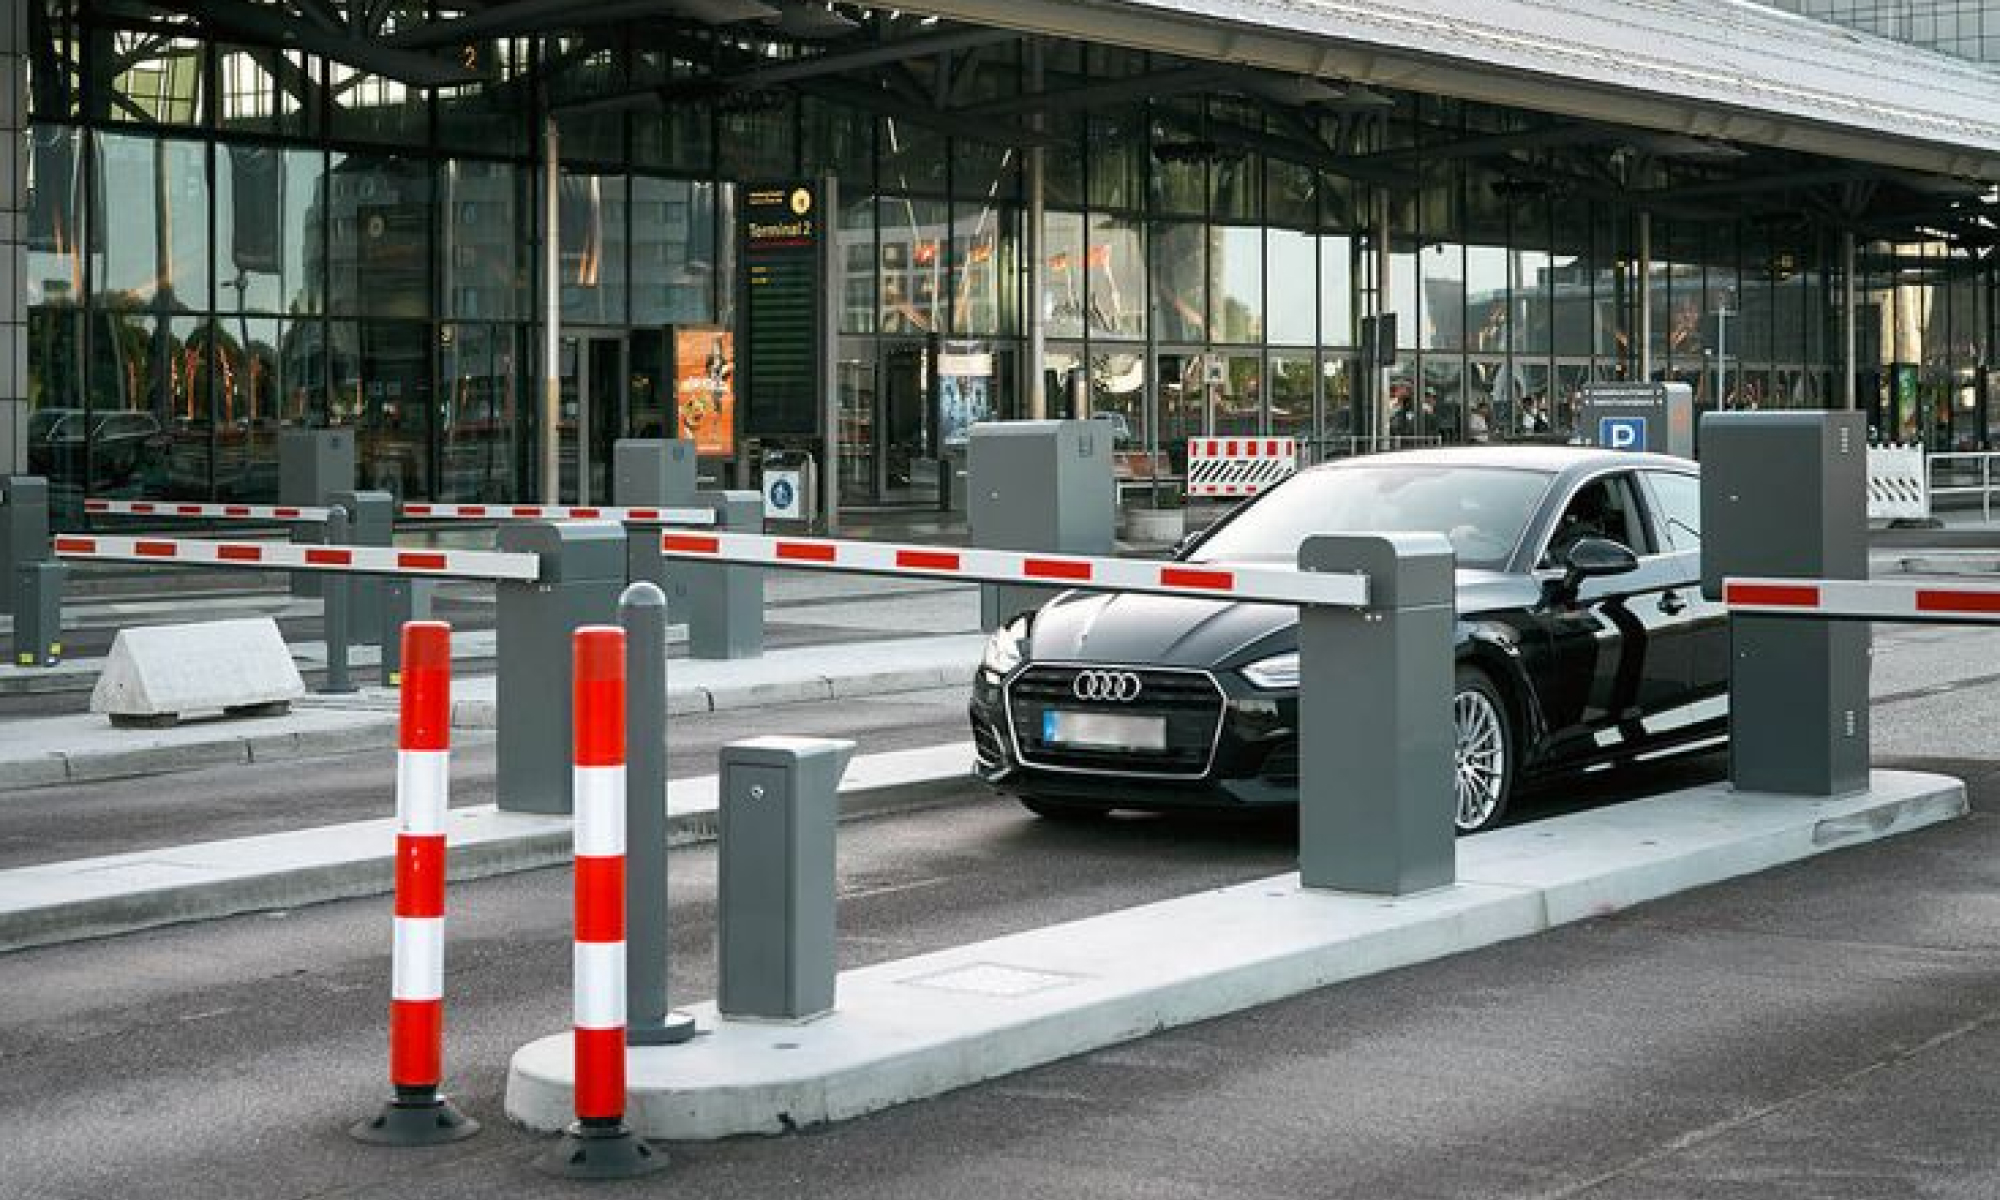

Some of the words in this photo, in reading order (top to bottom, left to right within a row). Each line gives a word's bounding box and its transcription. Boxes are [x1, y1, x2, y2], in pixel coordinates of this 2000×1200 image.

[749, 221, 801, 237] Terminal
[803, 220, 812, 235] 2
[1612, 424, 1636, 448] P
